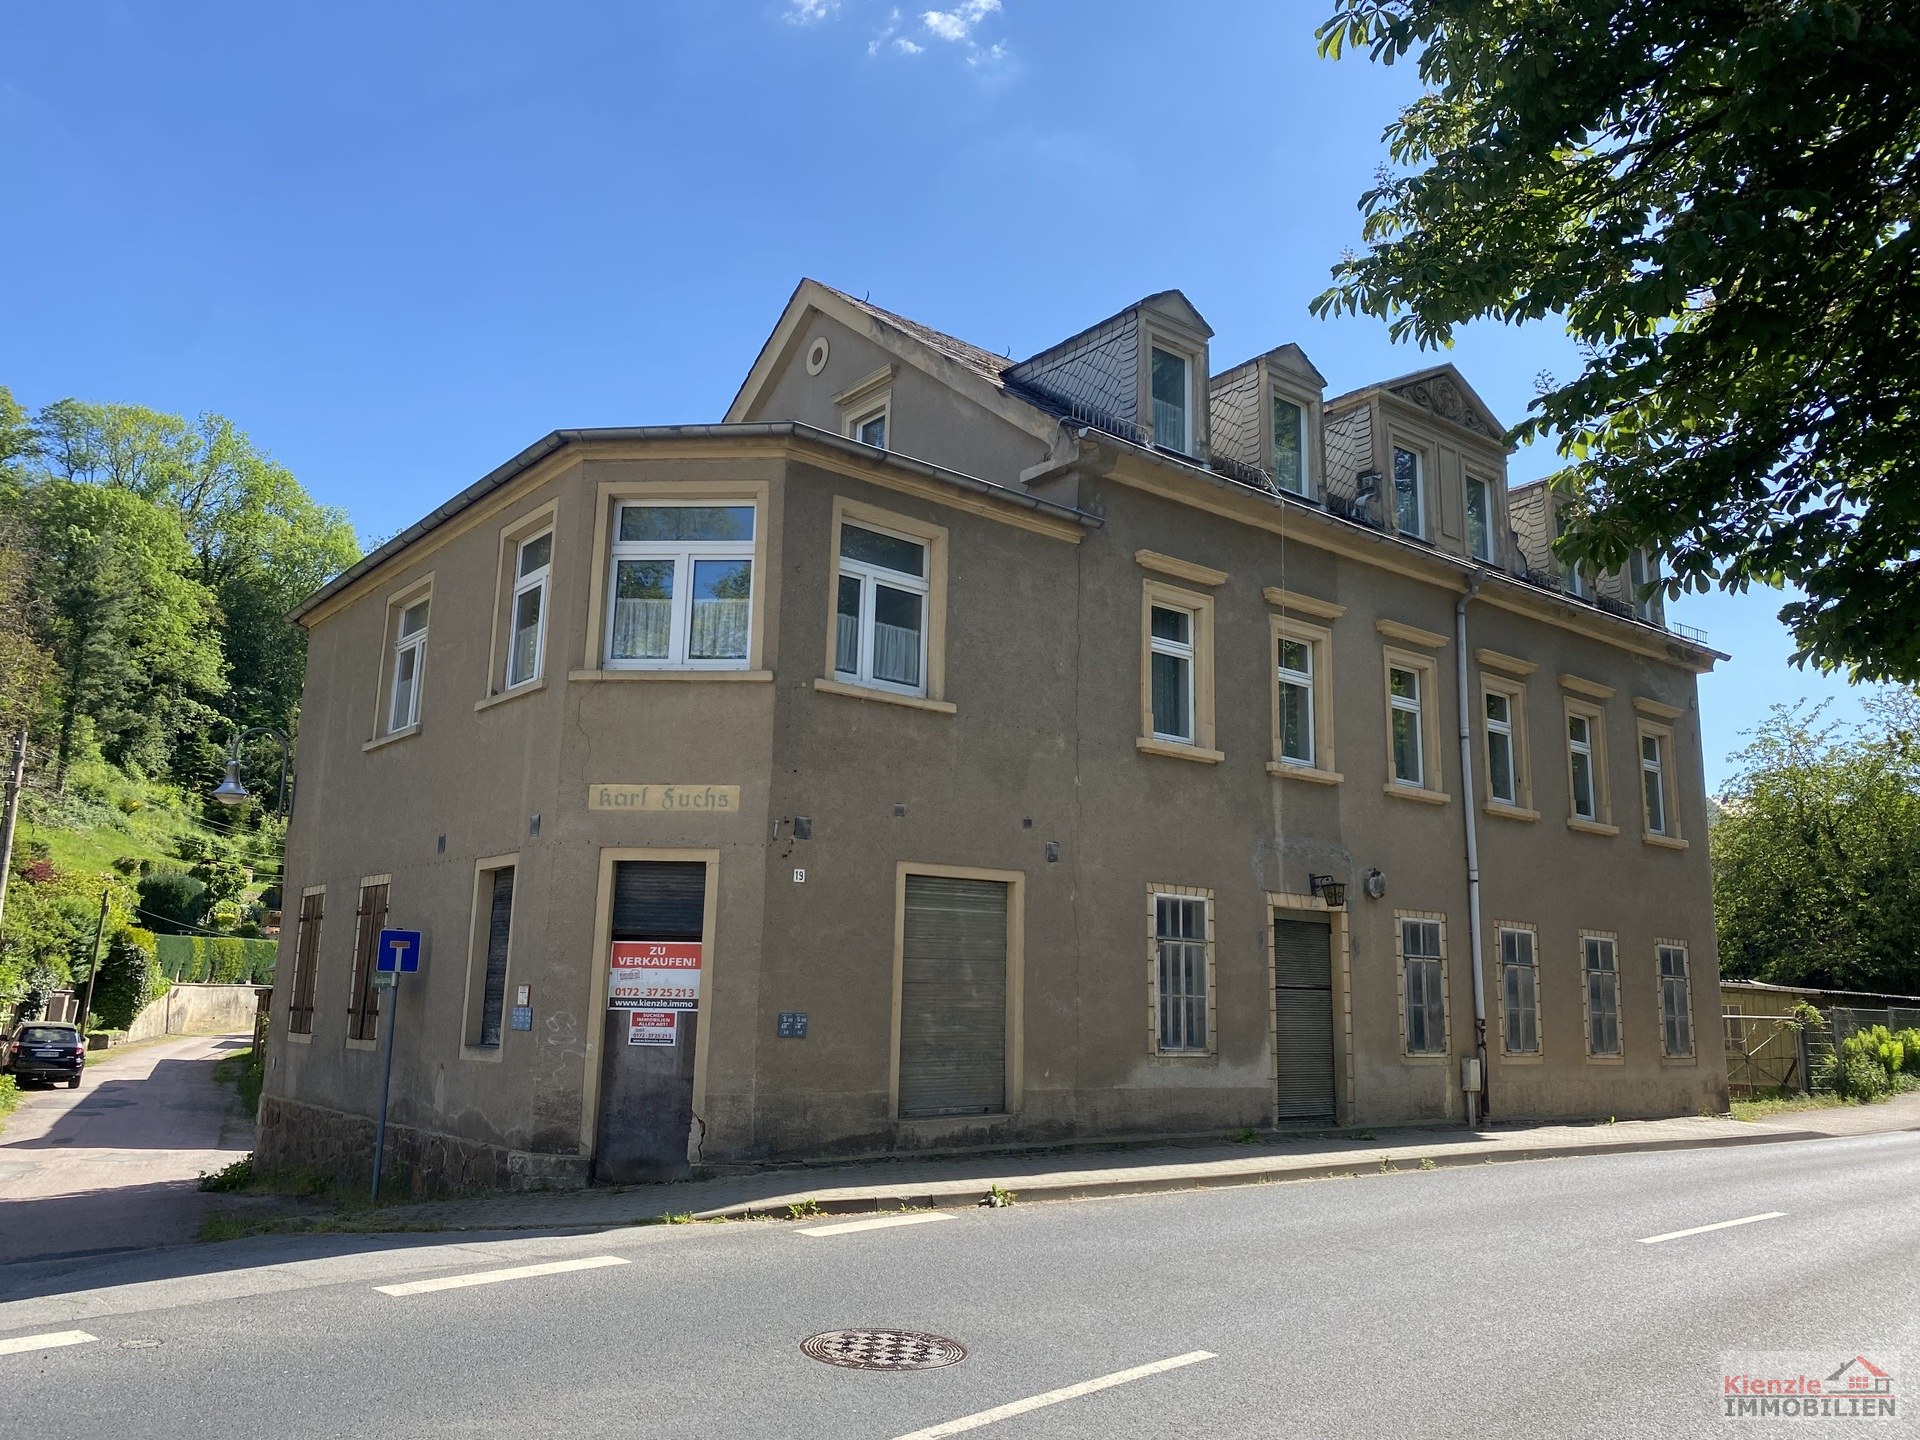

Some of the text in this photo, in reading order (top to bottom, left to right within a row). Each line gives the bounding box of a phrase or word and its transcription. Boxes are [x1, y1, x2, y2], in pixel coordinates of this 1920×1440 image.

[661, 786, 728, 810] Fuchs
[795, 870, 804, 881] 19
[649, 946, 666, 956] ZU
[618, 956, 696, 967] VERKAUFEN!
[615, 987, 640, 997] 0172
[646, 987, 658, 997] 37
[660, 988, 673, 998] 25
[615, 999, 694, 1008] www.kienzle.immo
